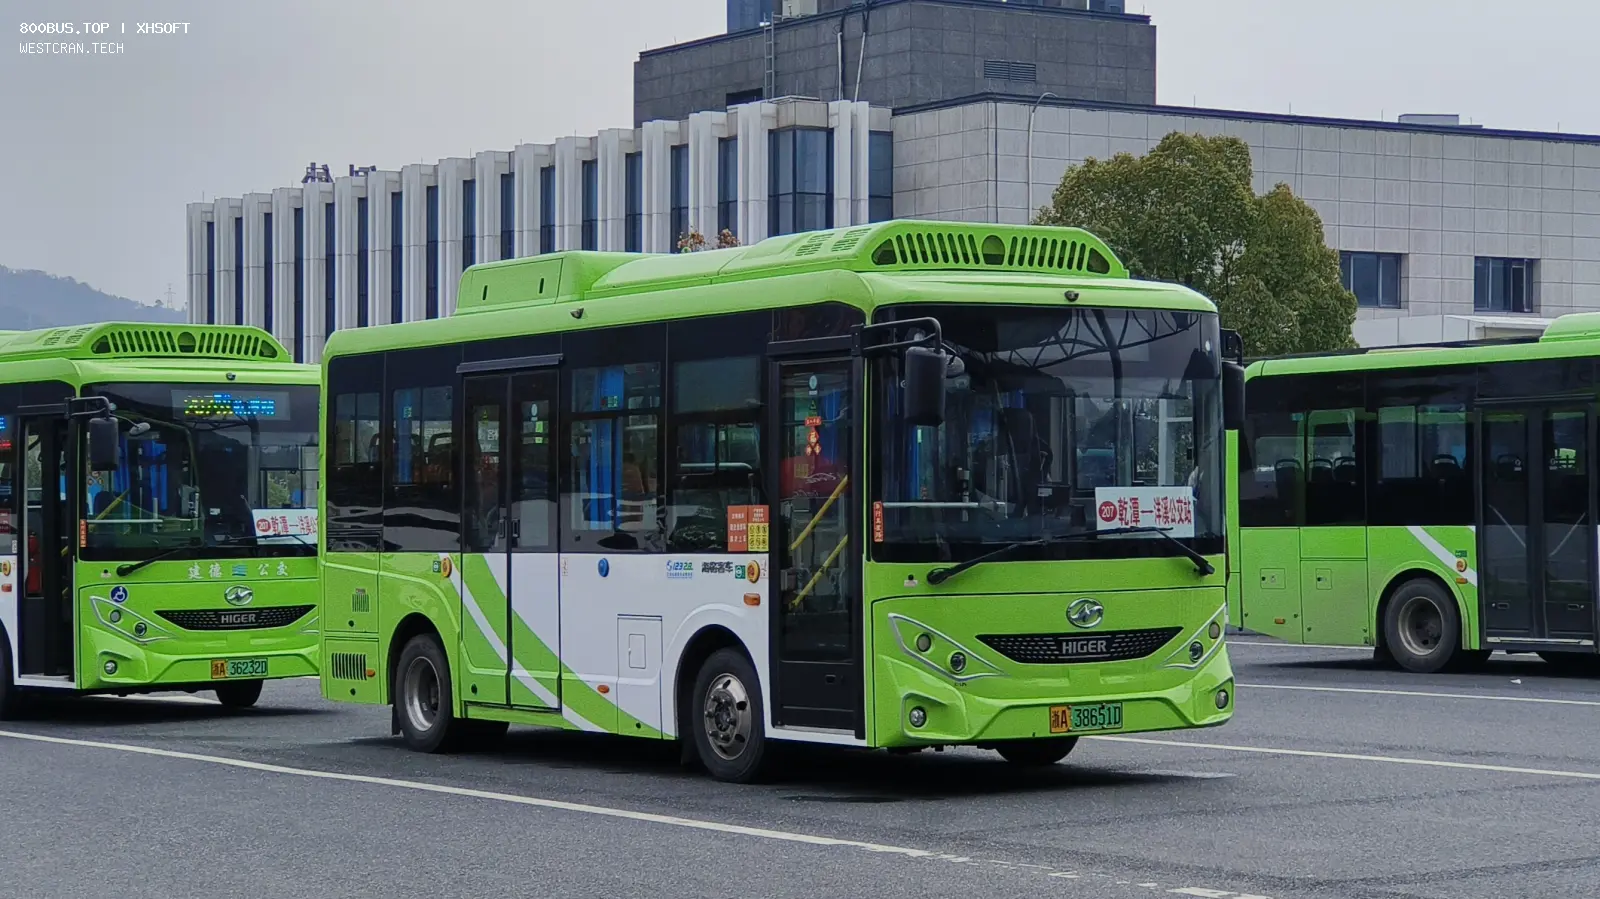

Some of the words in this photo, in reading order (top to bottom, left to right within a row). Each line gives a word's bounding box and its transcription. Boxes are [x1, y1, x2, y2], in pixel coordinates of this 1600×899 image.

[1101, 505, 1114, 518] 207
[221, 613, 256, 624] HIGER
[1062, 640, 1107, 655] HIGER
